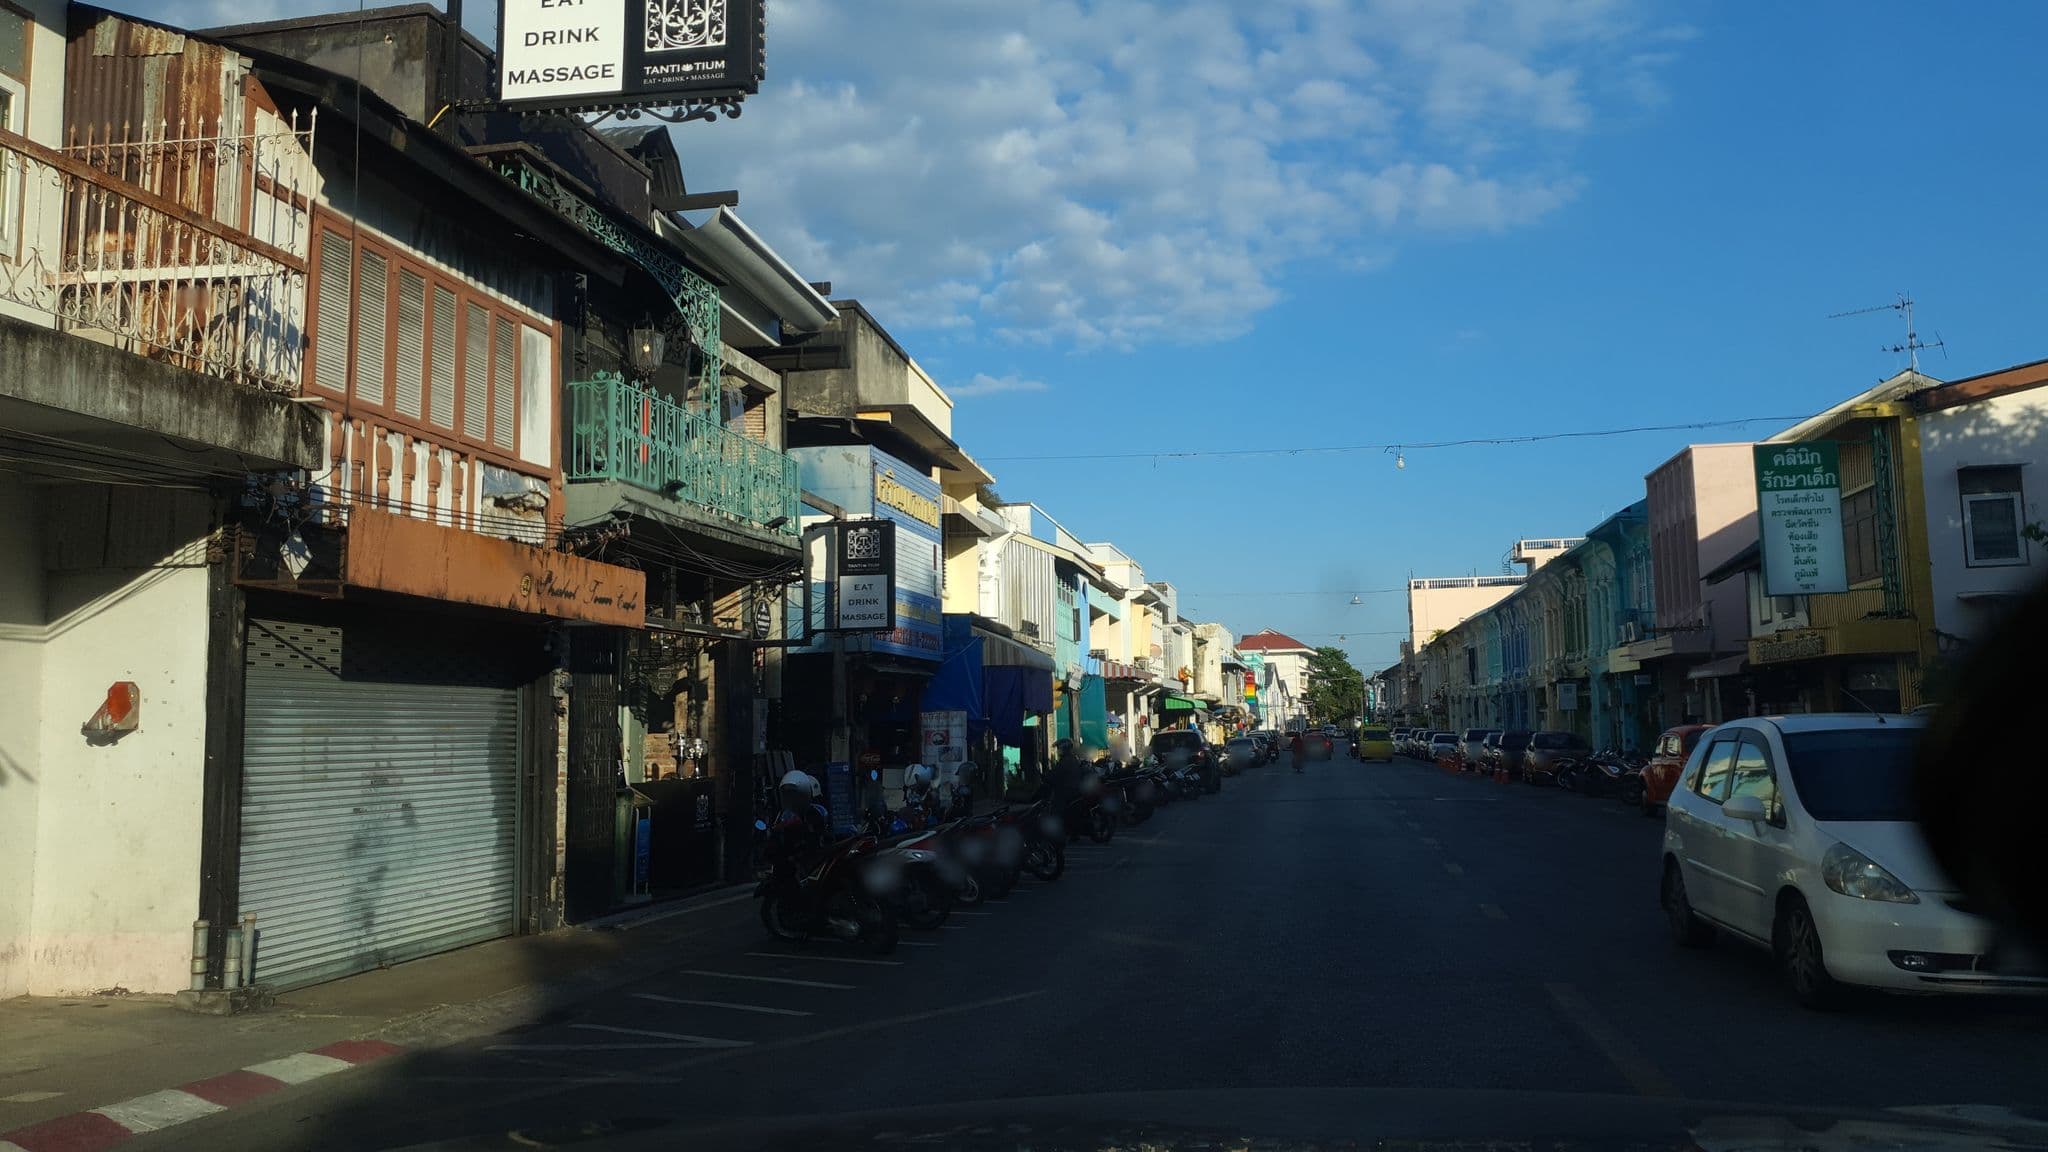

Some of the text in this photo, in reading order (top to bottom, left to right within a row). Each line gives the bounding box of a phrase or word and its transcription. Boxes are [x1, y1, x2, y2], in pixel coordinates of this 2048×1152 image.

[525, 26, 600, 47] DRINK
[508, 63, 615, 85] MASSAGE
[690, 72, 725, 81] MASSAGE
[1773, 447, 1821, 466] คลินิก
[1761, 465, 1836, 488] รักษาเด็ก
[854, 583, 874, 591] EAT
[848, 598, 879, 606] DRINK
[842, 612, 885, 621] MASSAGE
